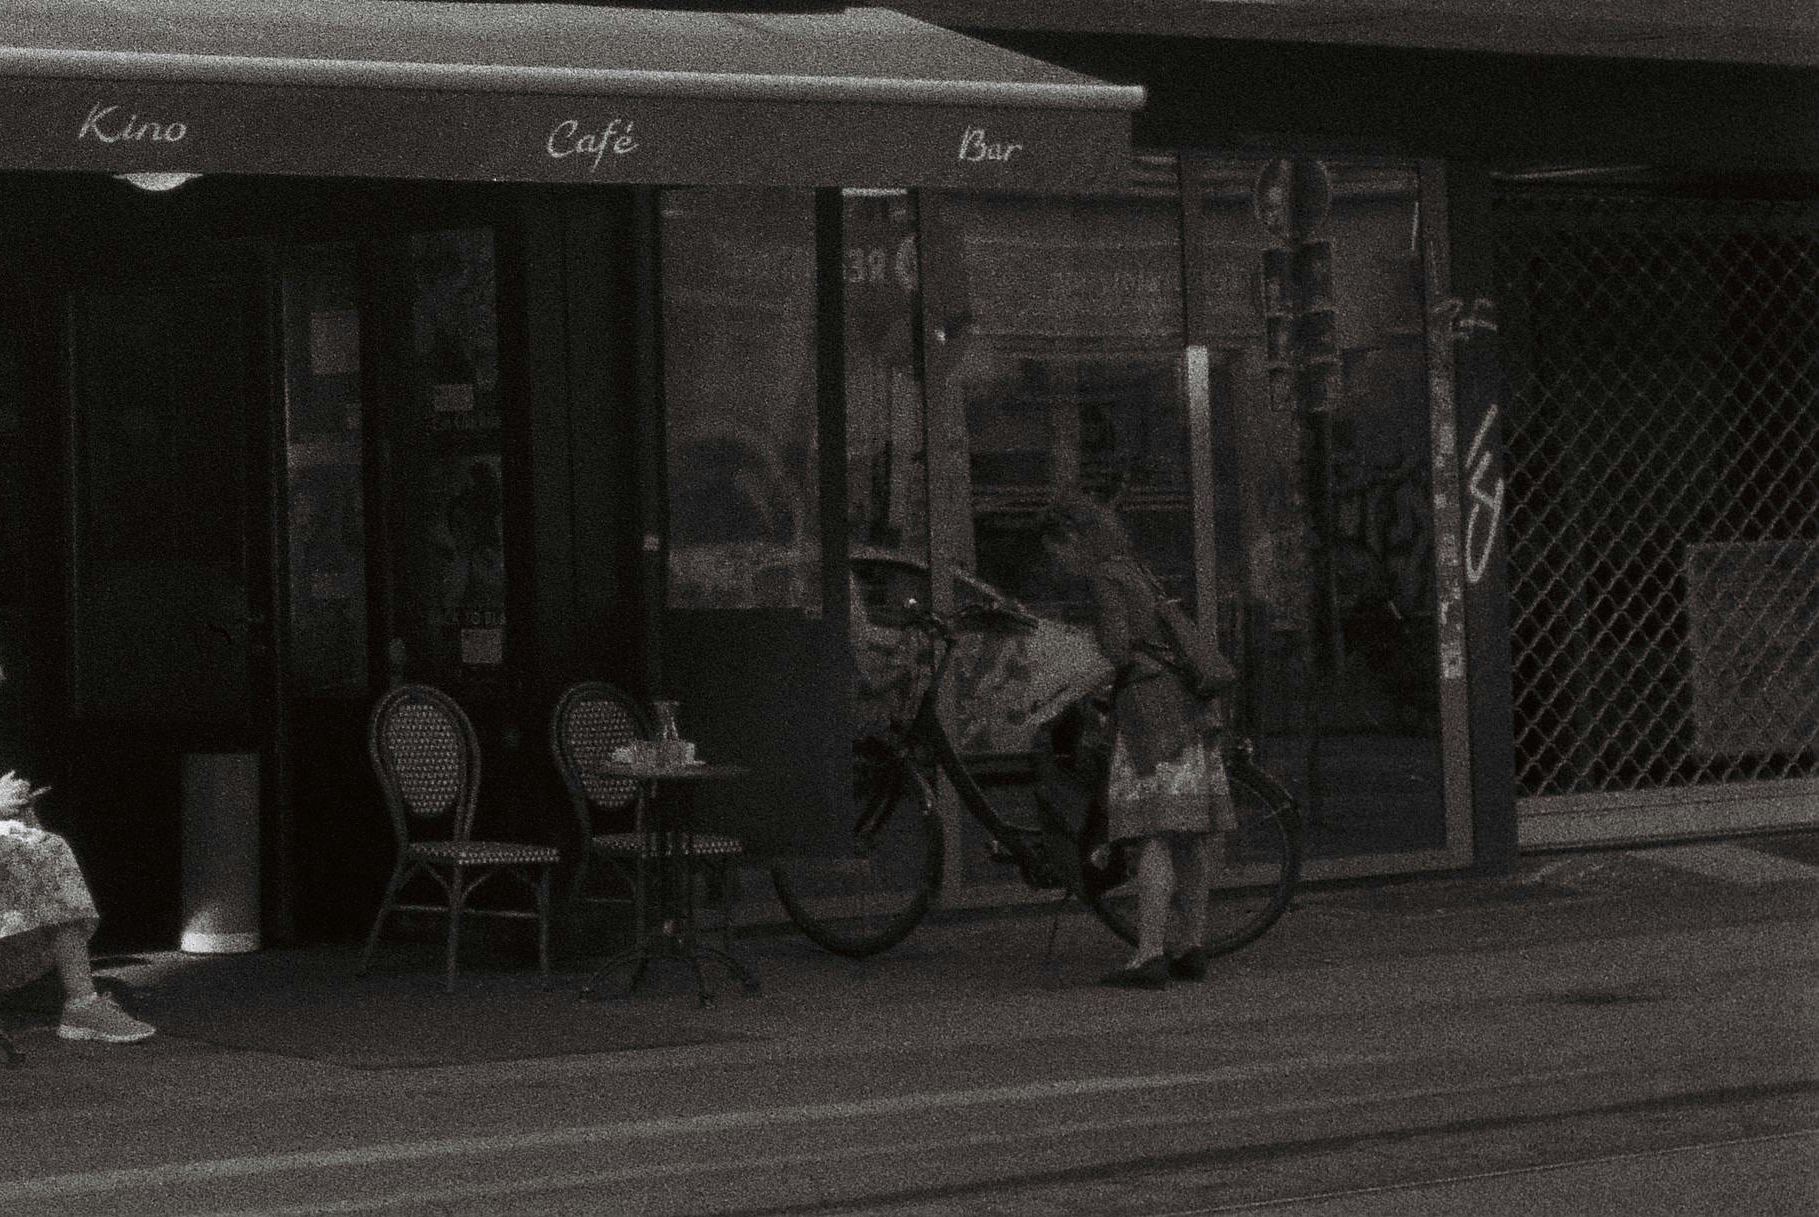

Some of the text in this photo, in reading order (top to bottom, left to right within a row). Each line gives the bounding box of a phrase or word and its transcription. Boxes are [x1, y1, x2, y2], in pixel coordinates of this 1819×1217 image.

[79, 99, 188, 144] Kino
[958, 125, 1024, 163] Bar
[547, 118, 641, 173] Café
